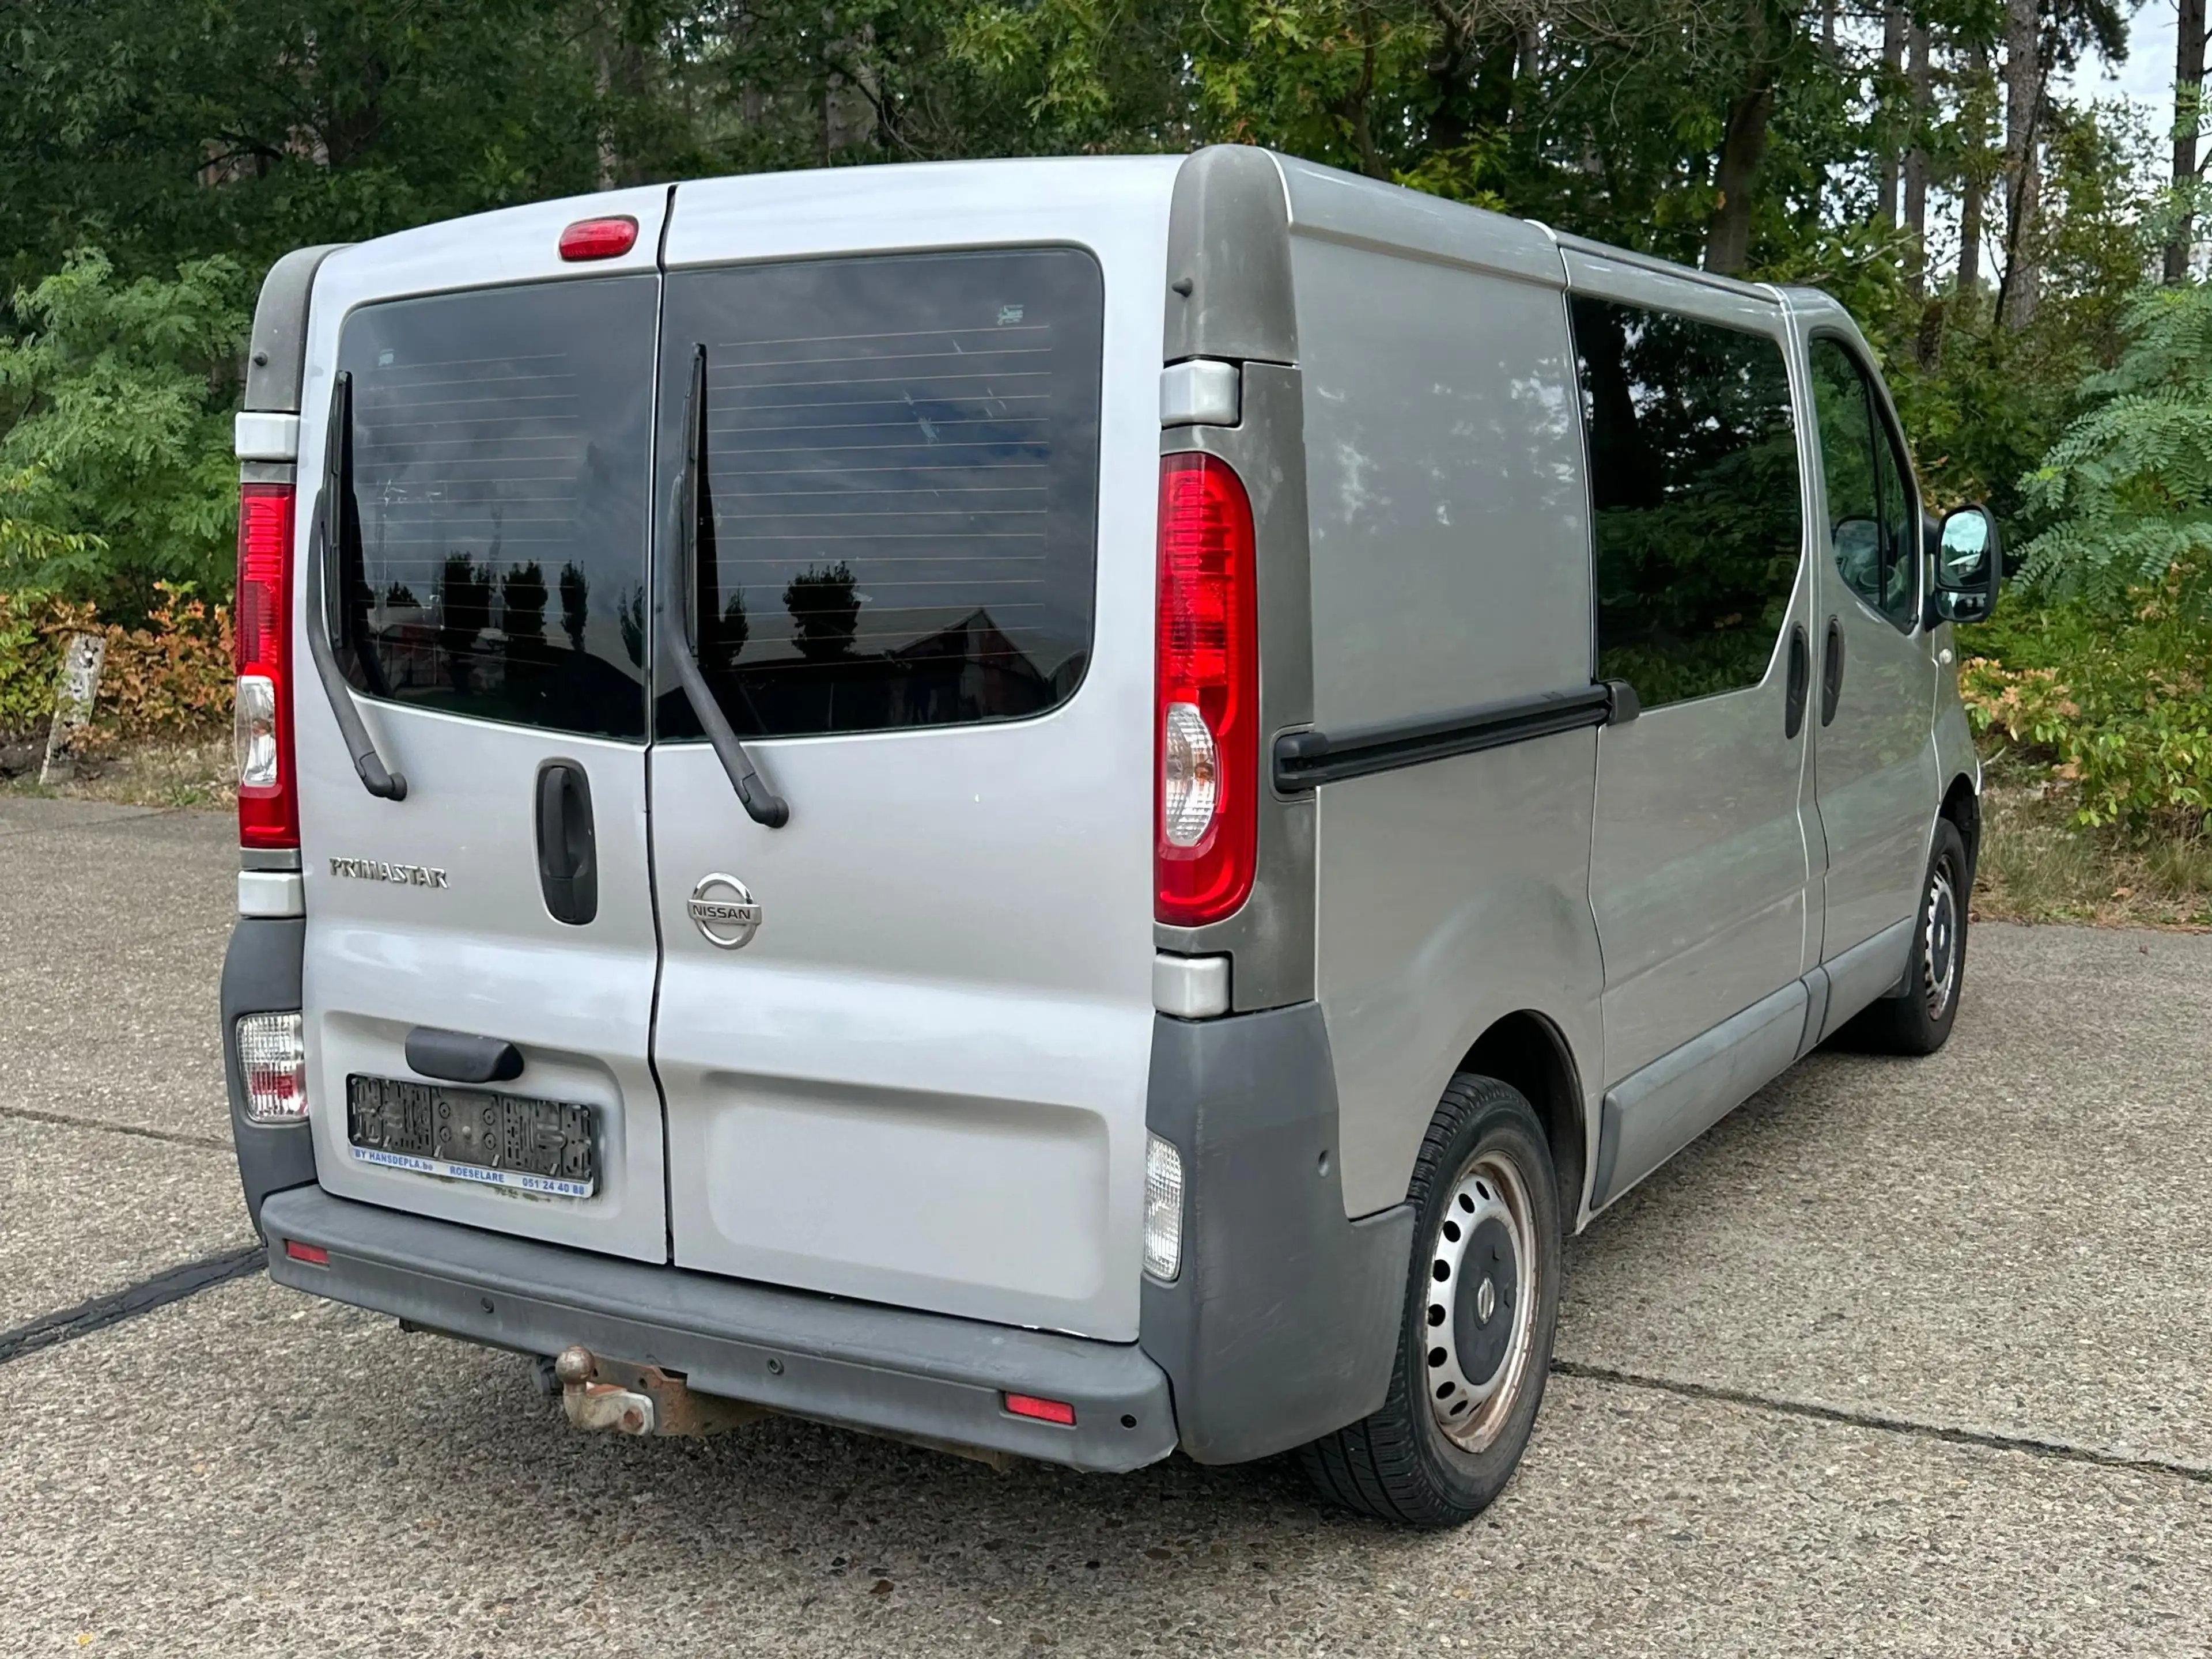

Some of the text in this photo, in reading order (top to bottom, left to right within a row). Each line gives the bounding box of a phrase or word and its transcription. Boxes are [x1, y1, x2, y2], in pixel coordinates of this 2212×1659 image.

[329, 857, 449, 889] PRIMASTAR
[693, 904, 751, 920] NISSAN
[355, 1149, 366, 1158] BY
[369, 1153, 433, 1171] HANSDEPLA.be
[449, 1165, 505, 1183] ROESELARE
[522, 1177, 539, 1188] 051
[543, 1180, 554, 1190] 24
[558, 1182, 569, 1192] 40
